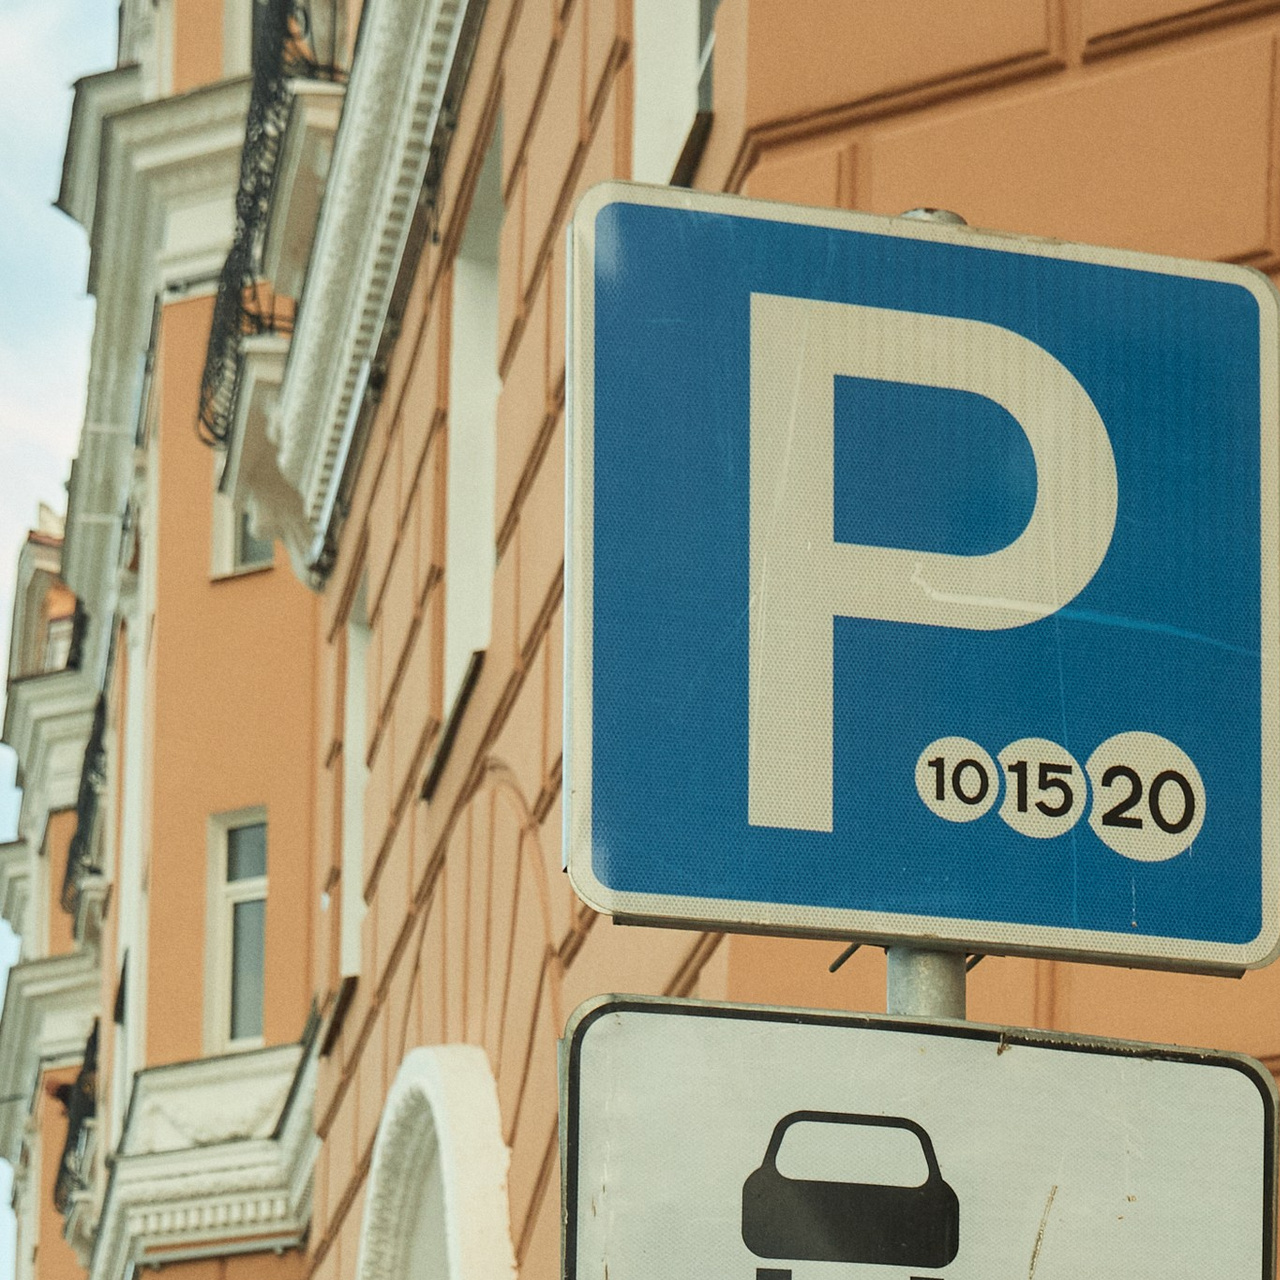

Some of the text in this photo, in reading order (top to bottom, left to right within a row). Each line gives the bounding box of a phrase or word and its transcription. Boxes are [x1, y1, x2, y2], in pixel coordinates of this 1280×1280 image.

[748, 292, 1118, 832] P
[927, 757, 1196, 834] 10 15 20
